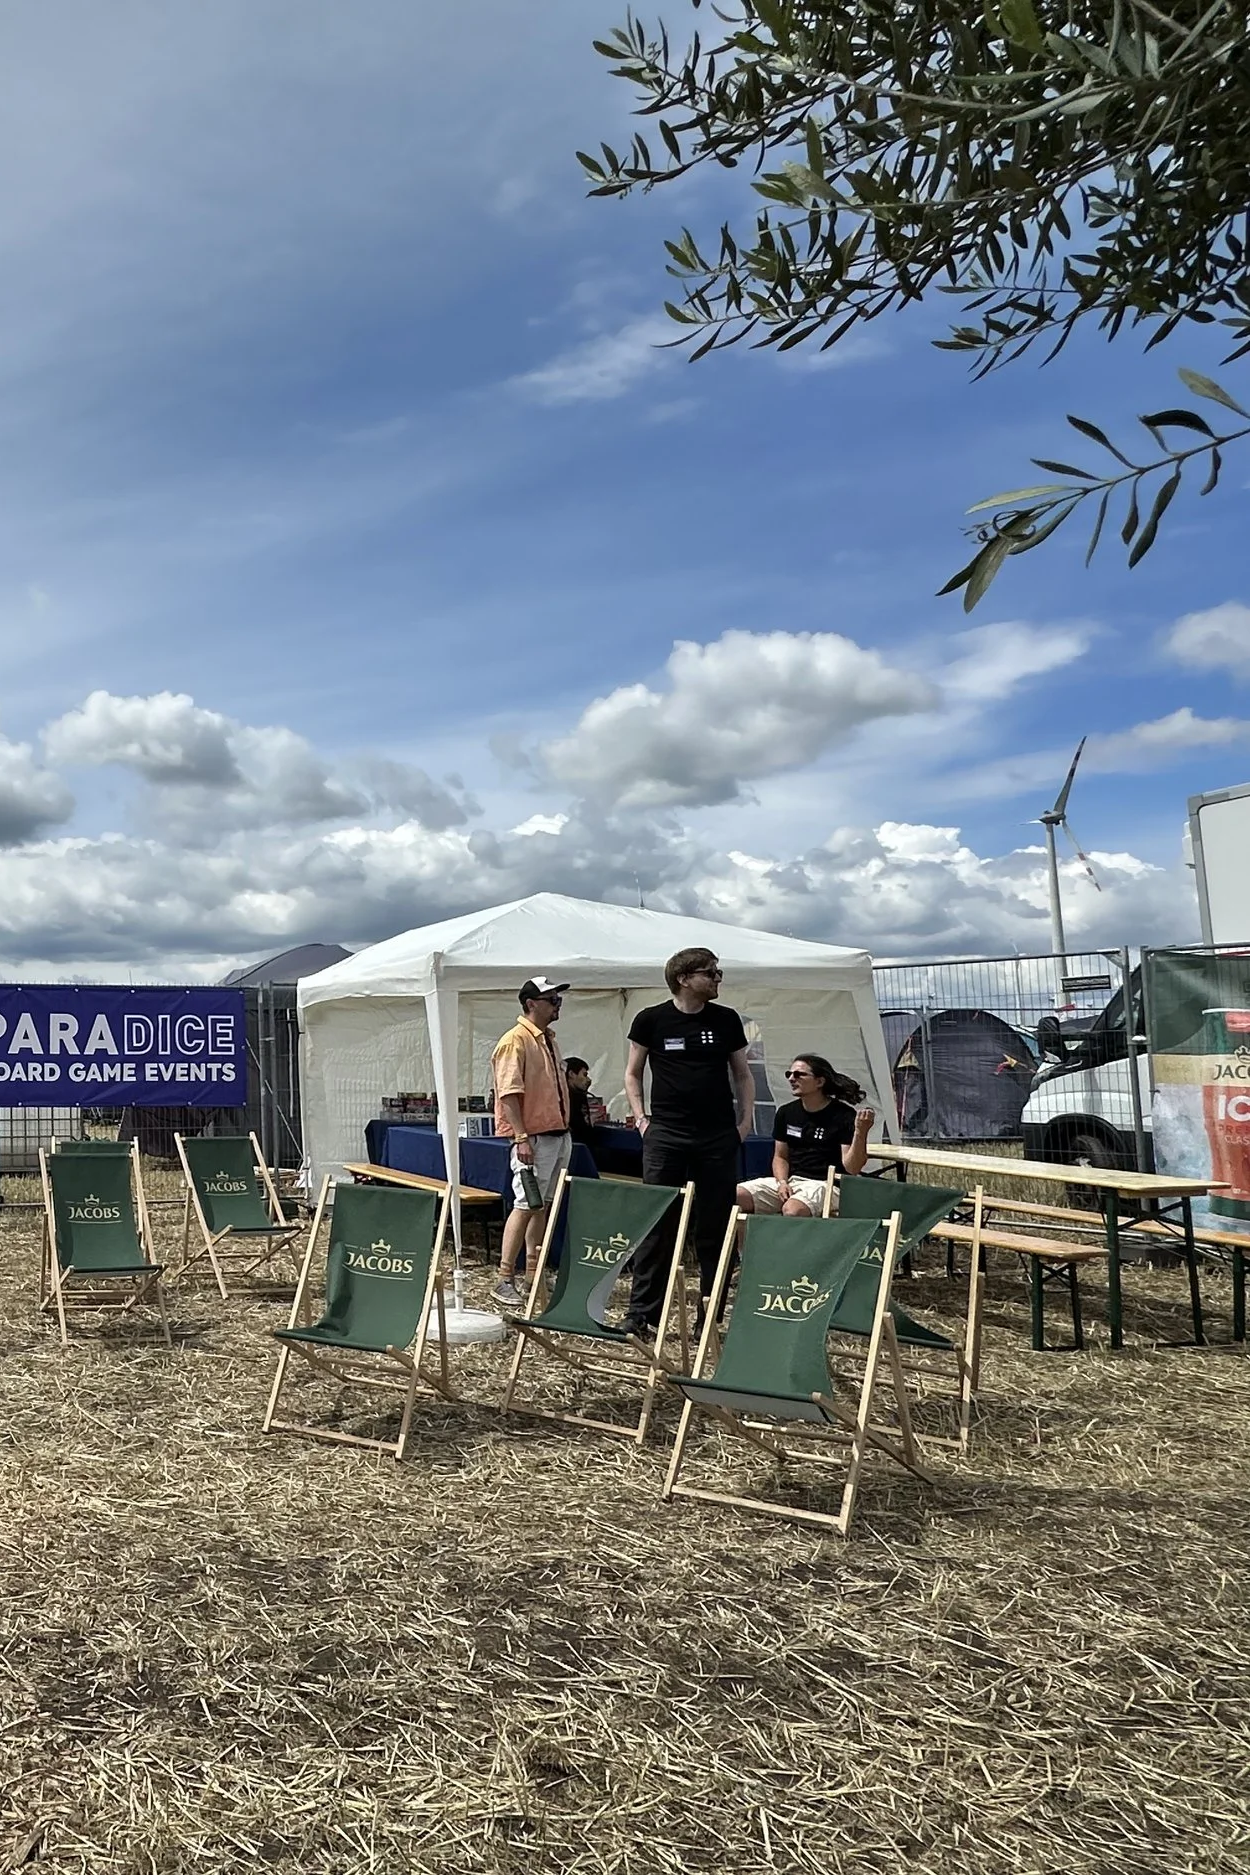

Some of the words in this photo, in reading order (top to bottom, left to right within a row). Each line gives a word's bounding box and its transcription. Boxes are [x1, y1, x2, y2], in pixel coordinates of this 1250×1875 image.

[68, 1062, 137, 1082] GAME
[144, 1062, 236, 1082] EVENTS
[1213, 1064, 1250, 1081] JAC
[203, 1180, 248, 1193] JACOBS
[68, 1206, 121, 1220] JACOBS
[344, 1251, 414, 1274] JACOBS
